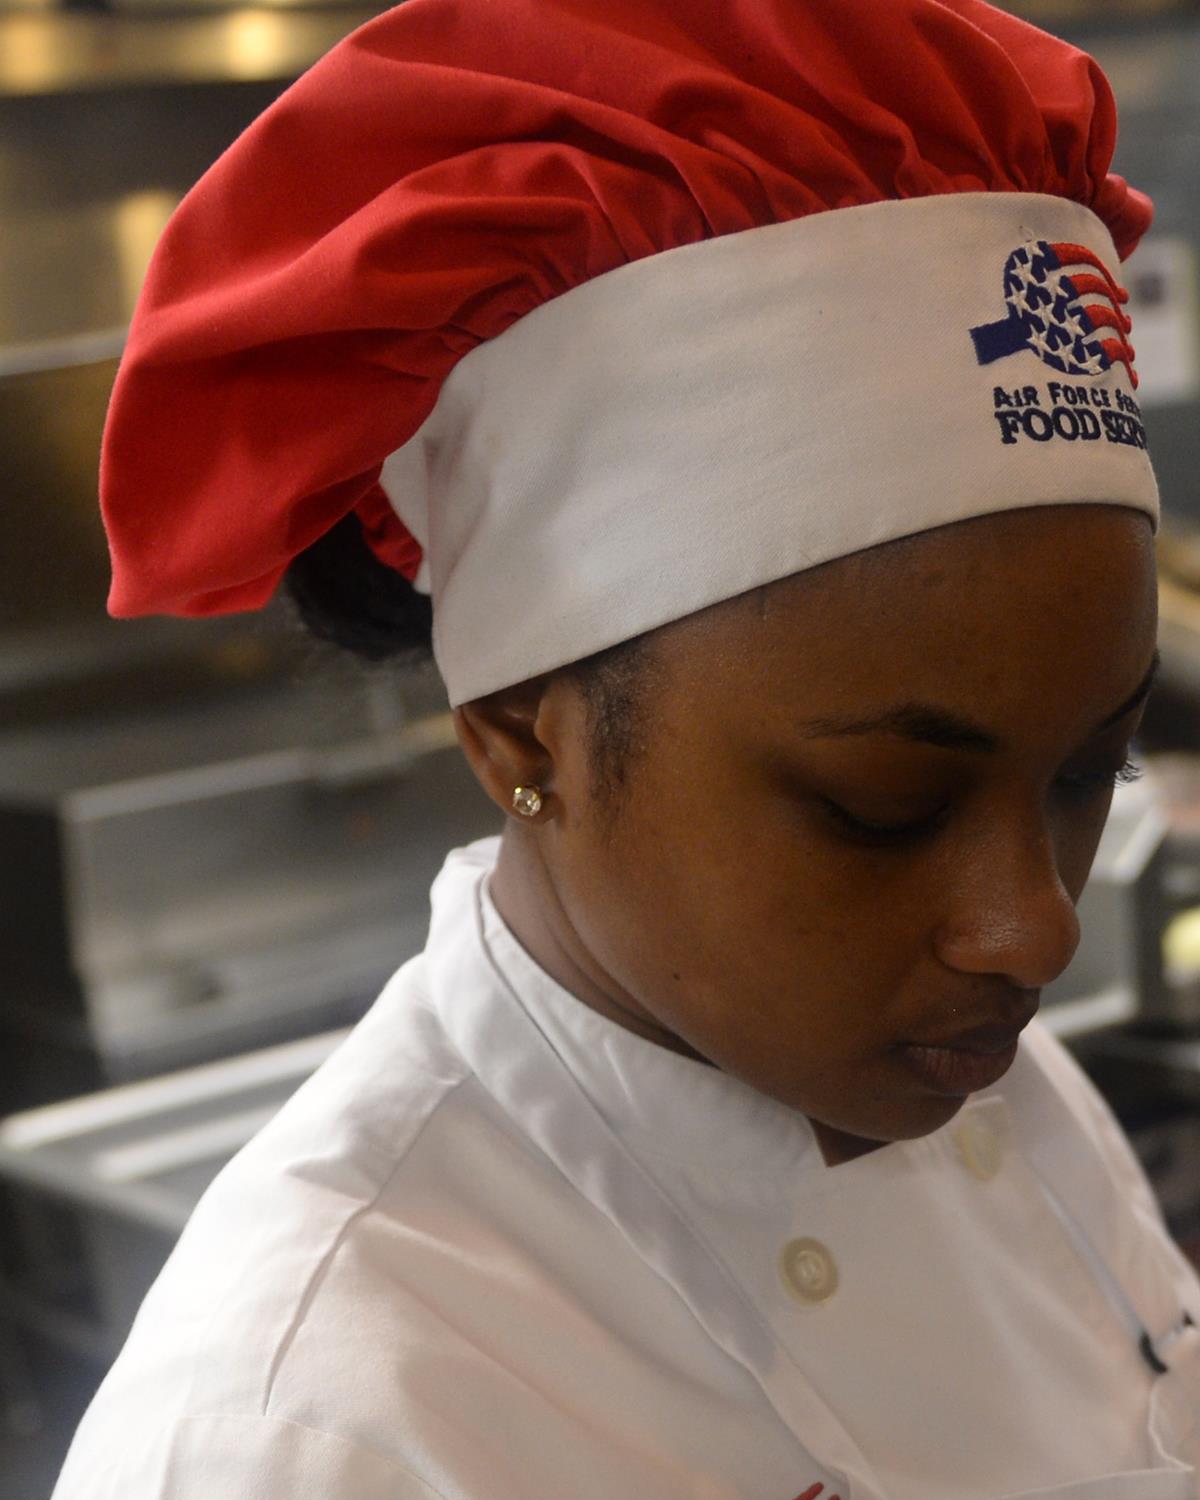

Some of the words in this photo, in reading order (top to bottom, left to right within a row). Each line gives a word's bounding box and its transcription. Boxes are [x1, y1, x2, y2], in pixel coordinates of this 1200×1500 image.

[993, 386, 1041, 408] AIR
[1047, 381, 1111, 408] FORCE
[994, 406, 1101, 444] FOOD
